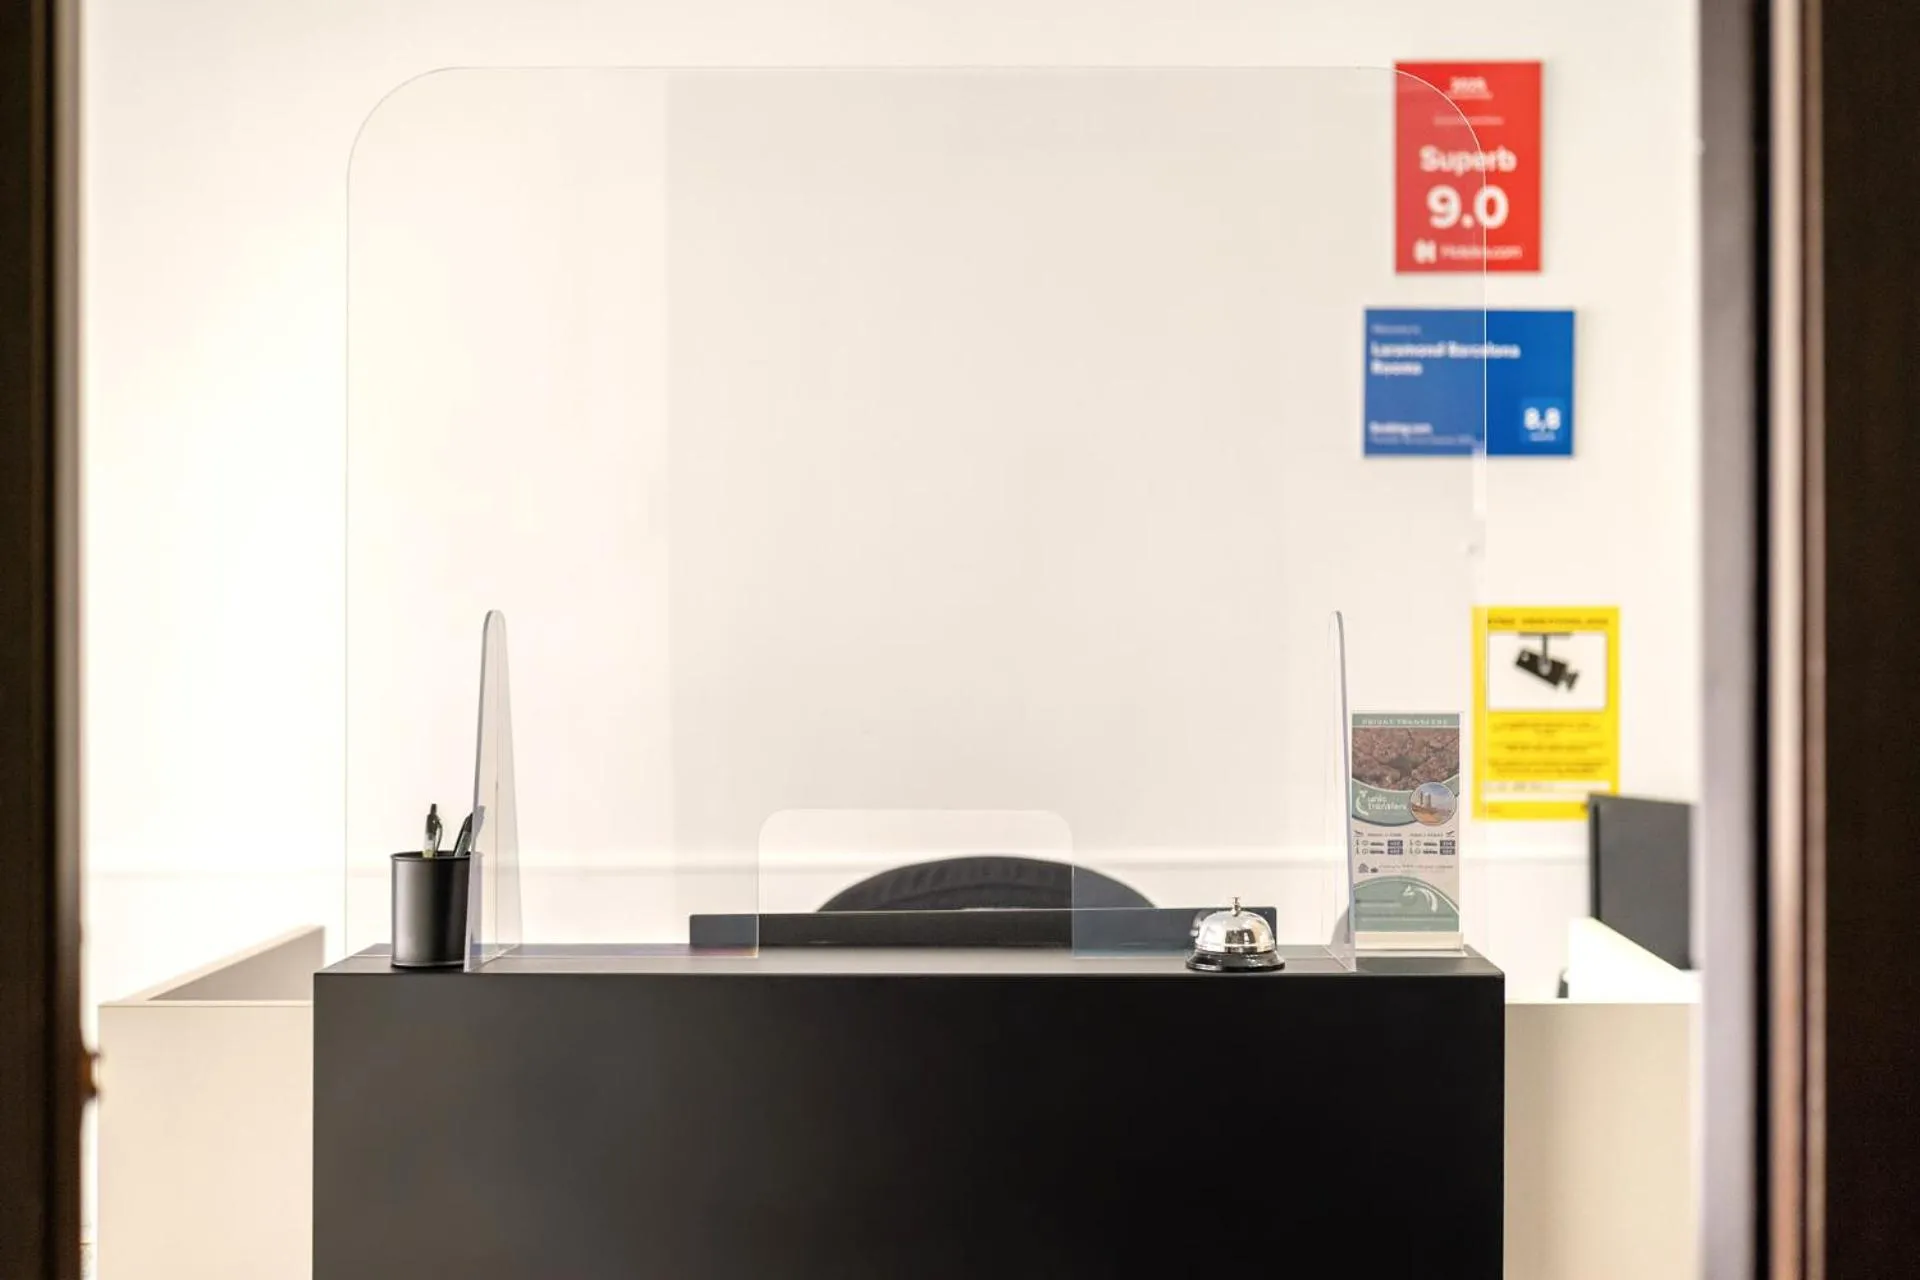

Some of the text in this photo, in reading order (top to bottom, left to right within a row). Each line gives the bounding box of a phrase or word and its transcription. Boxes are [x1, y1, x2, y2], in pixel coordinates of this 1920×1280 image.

[1419, 145, 1518, 177] Superb
[1426, 184, 1509, 230] 9.0
[1448, 340, 1521, 358] Barcelona
